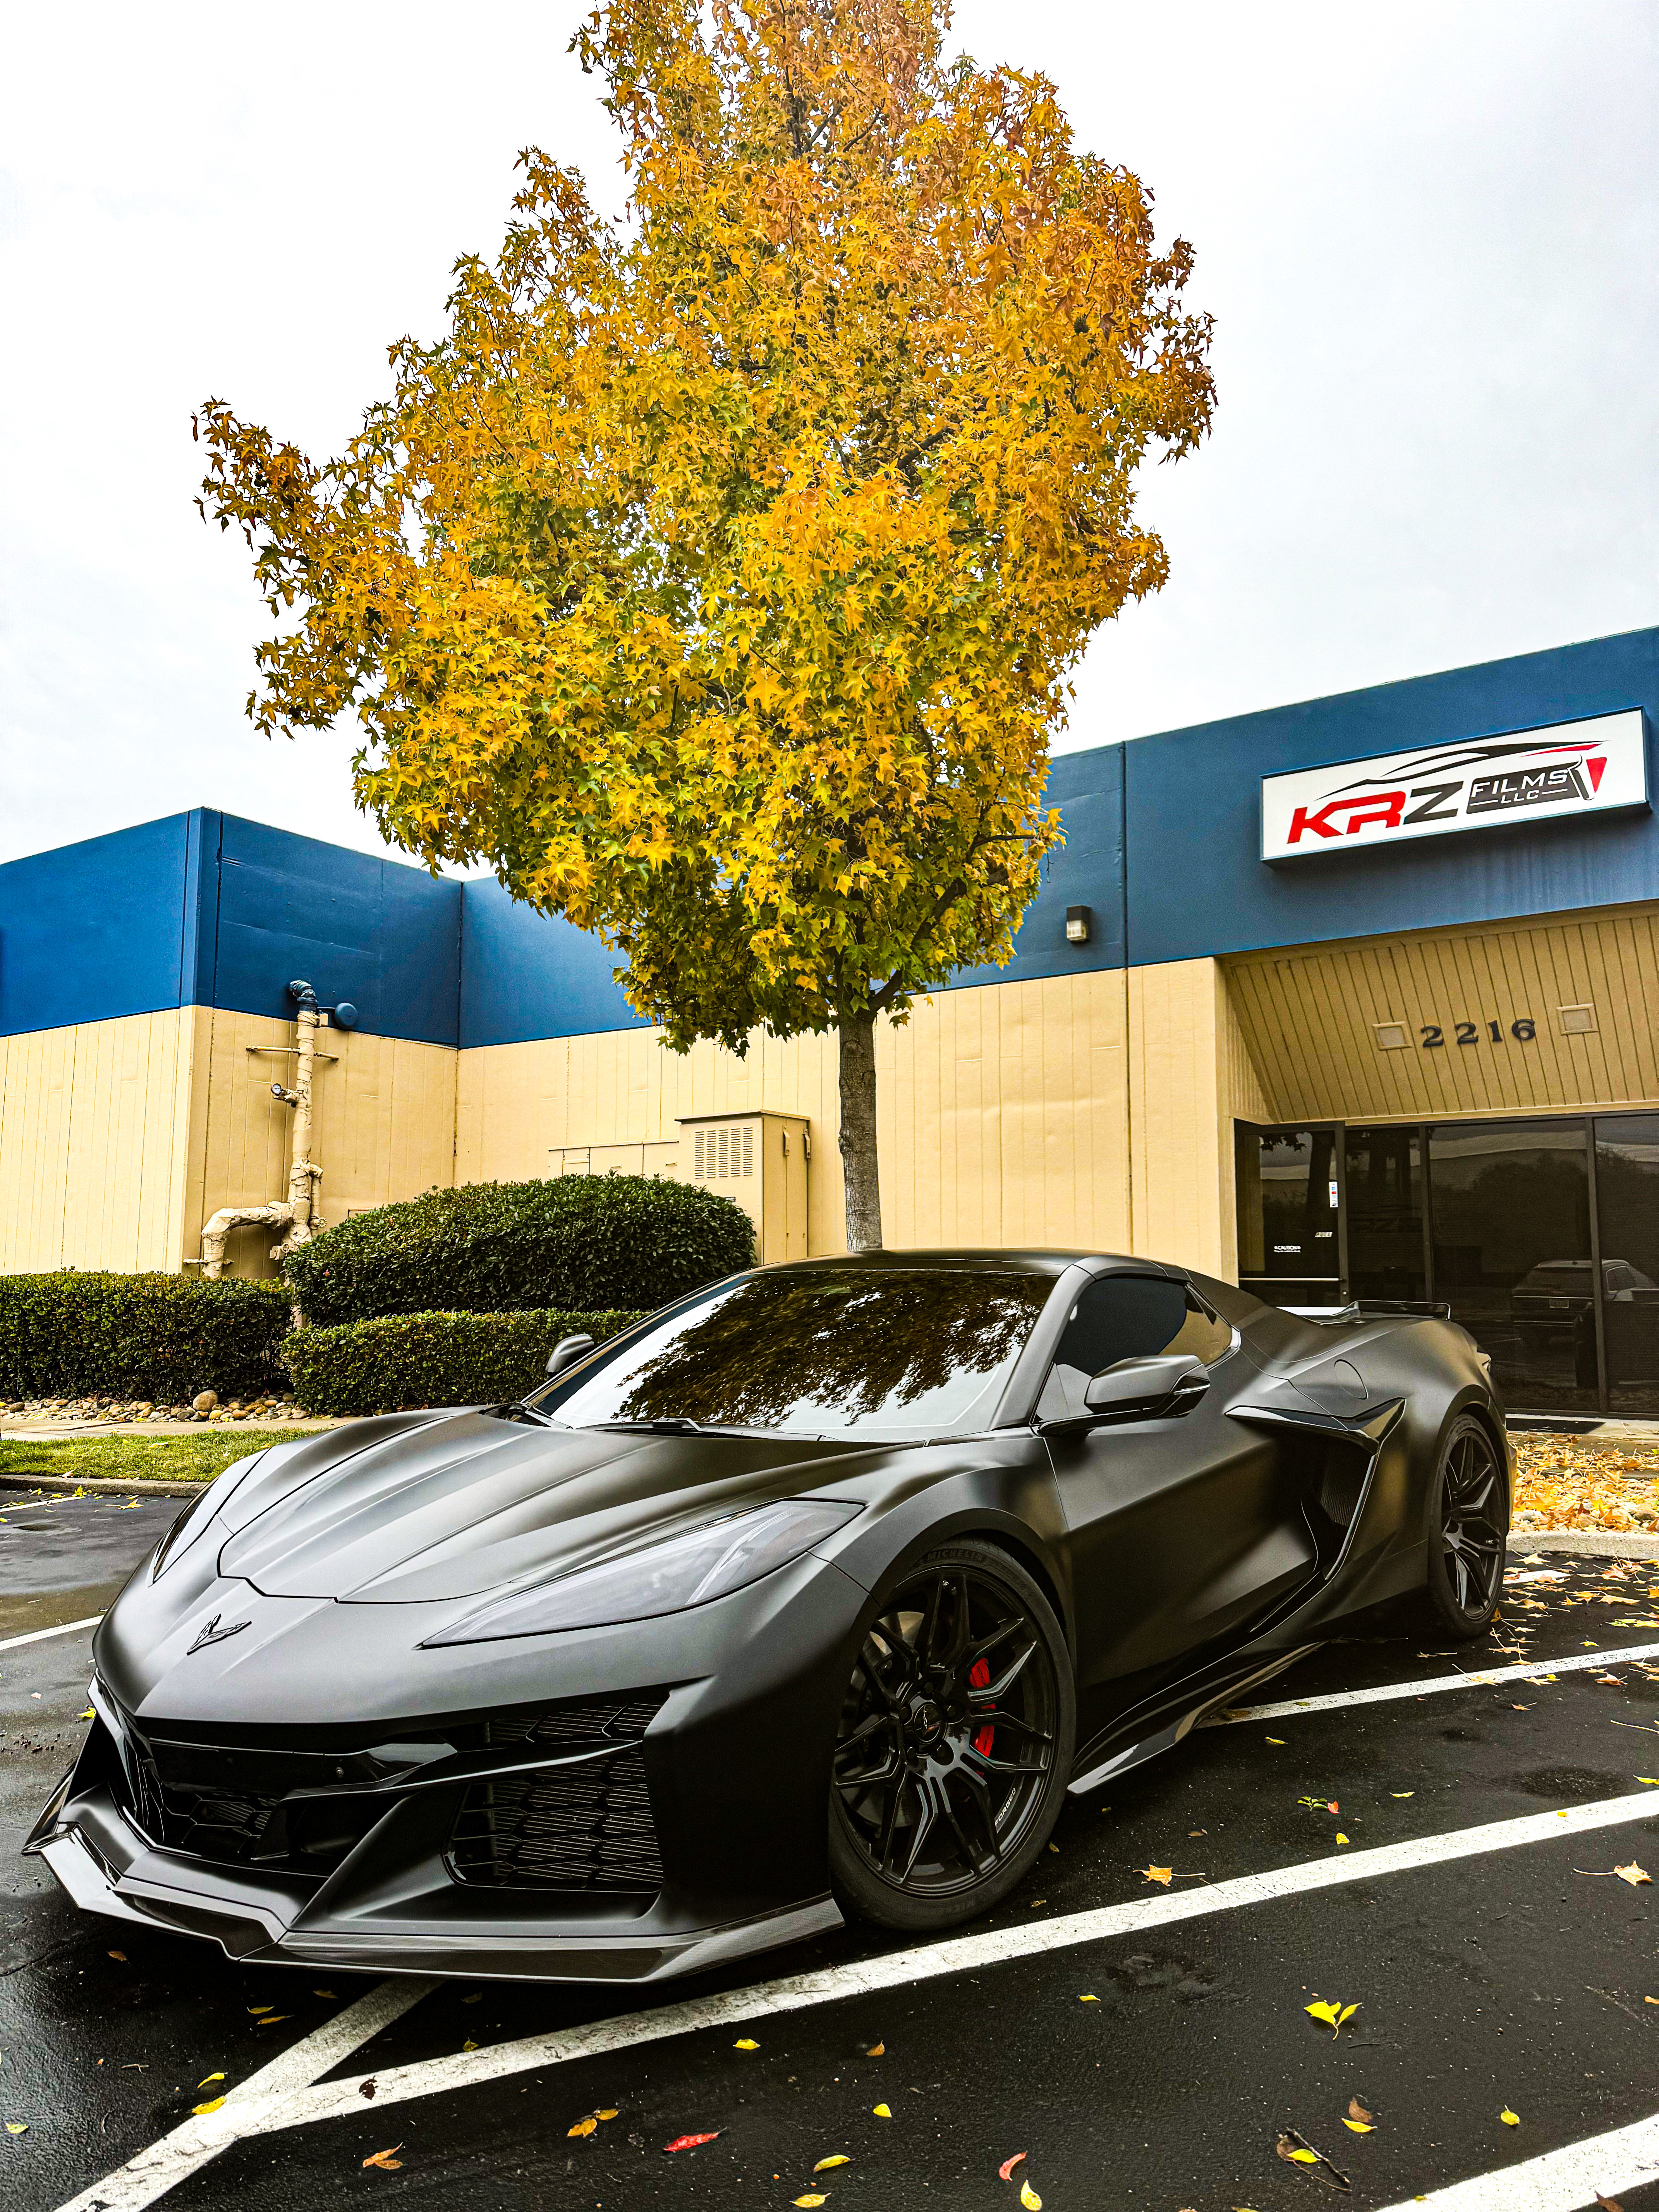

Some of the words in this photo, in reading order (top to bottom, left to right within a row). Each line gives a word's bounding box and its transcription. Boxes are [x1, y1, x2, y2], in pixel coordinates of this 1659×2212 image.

[1286, 781, 1464, 843] KRZ
[1471, 769, 1568, 797] FILMS
[1501, 789, 1539, 804] LLC
[1420, 1018, 1535, 1048] 2216
[927, 1548, 984, 1562] MICHELIN
